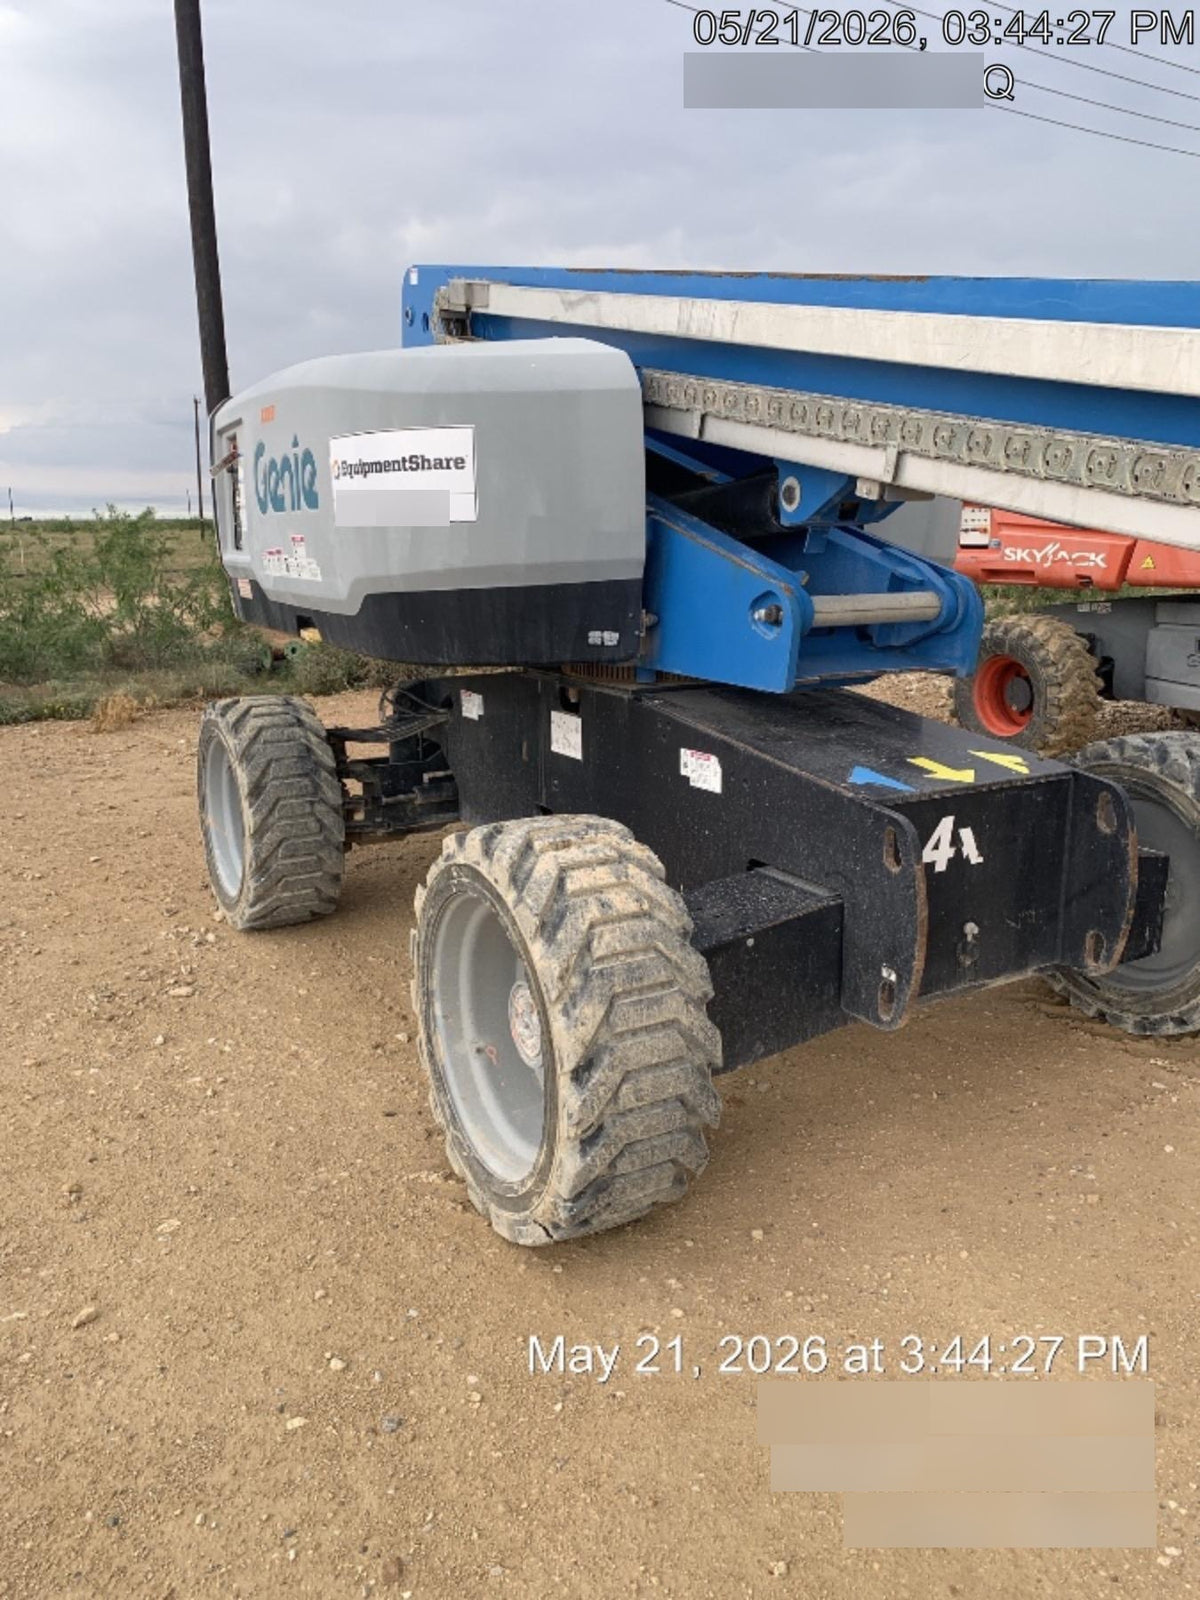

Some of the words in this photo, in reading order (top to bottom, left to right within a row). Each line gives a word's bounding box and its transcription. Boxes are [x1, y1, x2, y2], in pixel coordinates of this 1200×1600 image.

[254, 433, 320, 515] Genie
[340, 455, 467, 479] EquipmentShare
[1004, 542, 1108, 568] SKYJACK
